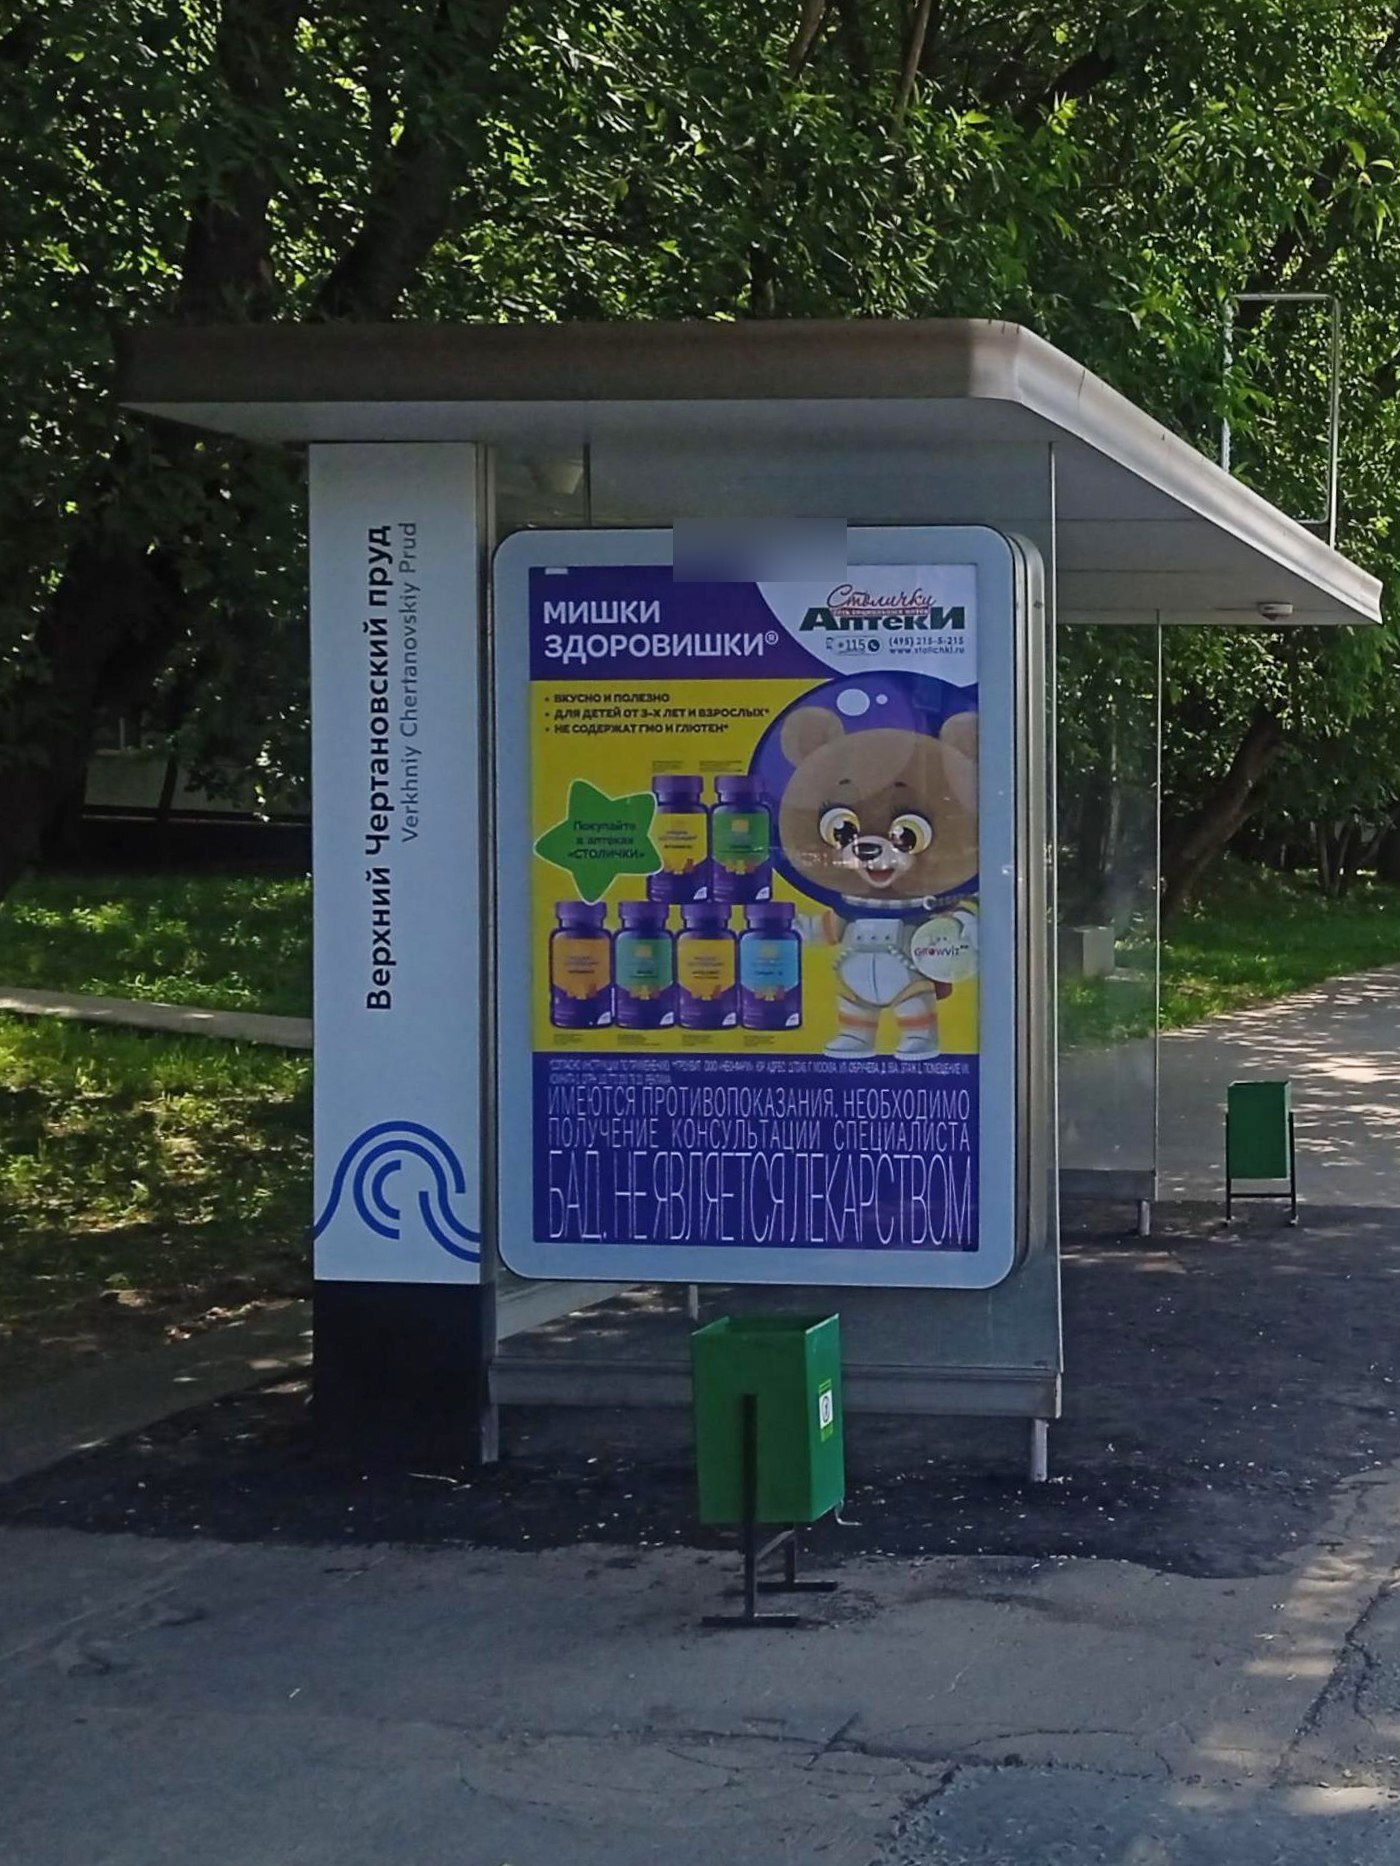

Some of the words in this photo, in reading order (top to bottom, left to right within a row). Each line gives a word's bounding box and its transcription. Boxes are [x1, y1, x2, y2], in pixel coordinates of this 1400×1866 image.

[368, 525, 394, 607] пруд
[398, 523, 418, 573] Prud
[543, 600, 661, 624] МИШКИ
[398, 582, 421, 737] Chertanovskiy
[553, 708, 580, 720] ДЛЯ
[582, 706, 622, 720] ДЕТЕЙ
[624, 708, 638, 718] ОТ
[662, 708, 686, 718] ЛЕТ
[687, 707, 697, 718] И
[554, 693, 602, 703] ВКУСНО
[603, 693, 613, 703] И
[613, 693, 670, 703] ПОЛЕЗНО
[363, 617, 395, 856] Чертановский
[553, 724, 571, 734] НЕ
[571, 723, 638, 735] СОДЕРЖАТ
[638, 724, 664, 734] ГМО
[665, 724, 674, 733] И
[400, 745, 423, 843] Verkhniy
[364, 867, 397, 1010] Верхний
[548, 1085, 636, 1117] ИМЕЮТСЯ
[641, 1086, 839, 1119] ПРОТИВОПОКАЗАНИЯ.
[843, 1088, 971, 1122] НЕОБХОДИМО
[548, 1117, 659, 1148] ПОЛУЧЕНИЕ
[671, 1119, 821, 1152] КОНСУЛЬТАЦИИ
[833, 1121, 971, 1152] СПЕЦИАЛИСТА
[549, 1150, 608, 1240] БАД.
[614, 1151, 648, 1240] НЕ
[652, 1152, 785, 1242] ЯВЛЯЕТСЯ
[790, 1153, 972, 1246] ЛЕКАРСТВОМ
